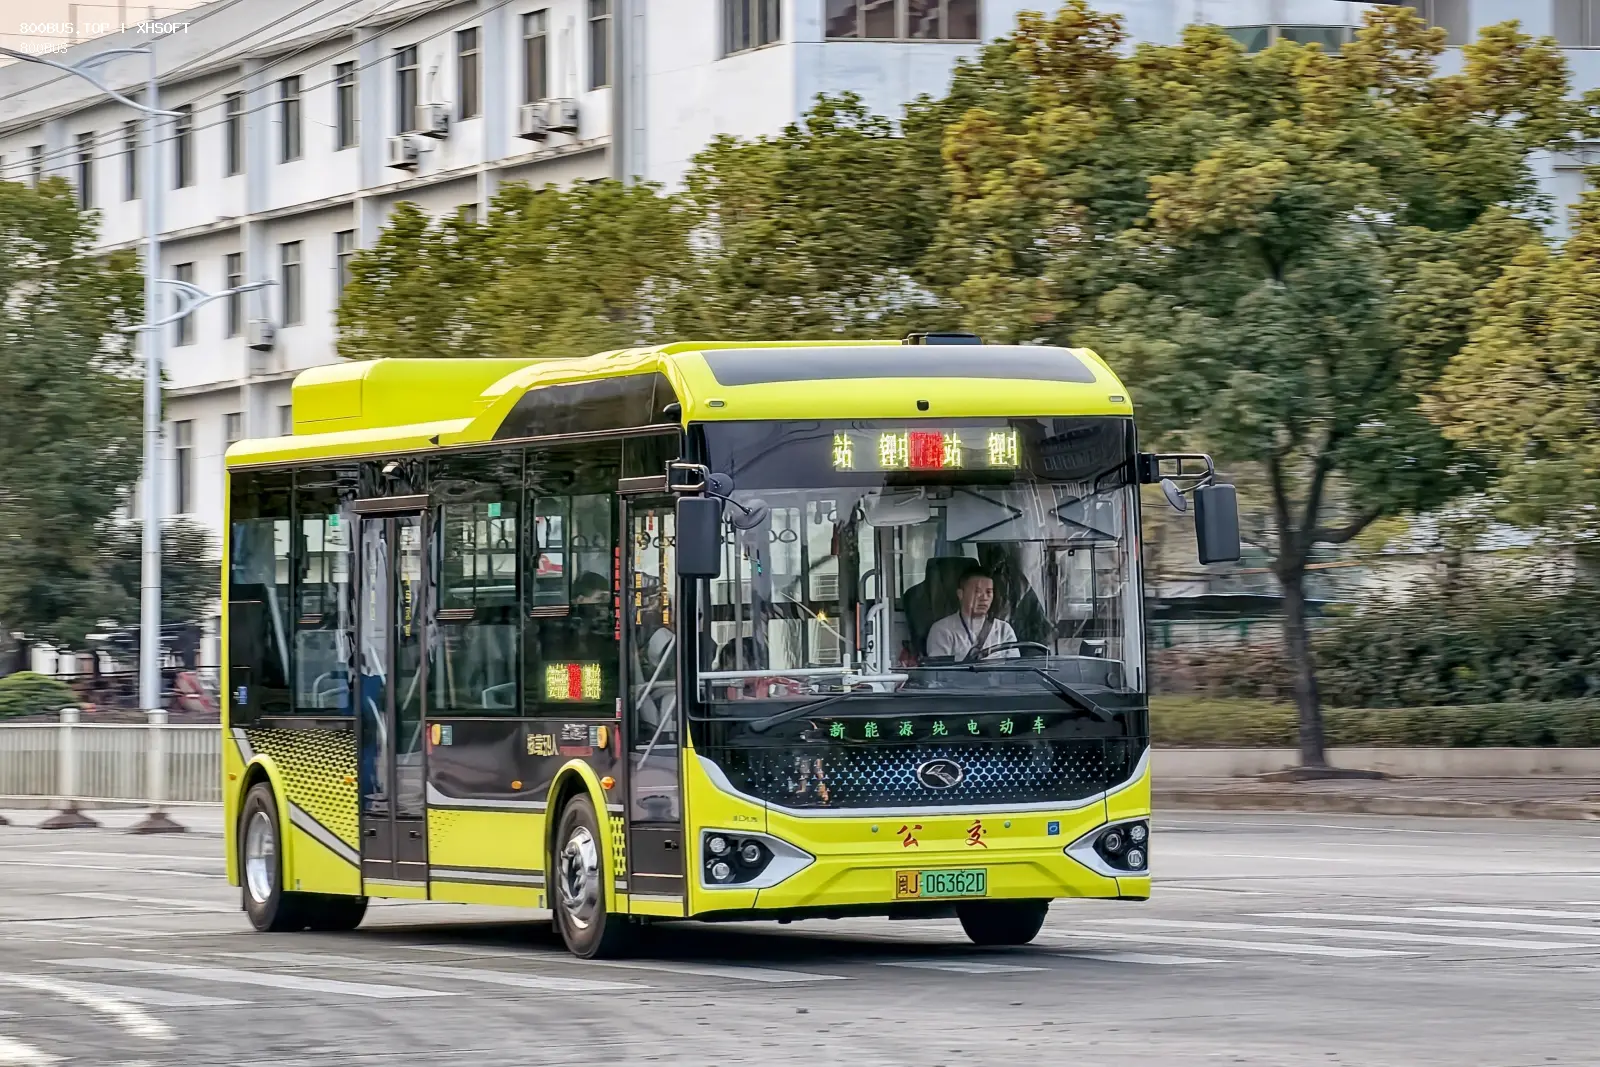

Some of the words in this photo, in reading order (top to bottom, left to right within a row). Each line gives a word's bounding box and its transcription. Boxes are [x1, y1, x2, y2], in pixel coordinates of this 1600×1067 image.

[829, 716, 1046, 740] 新能源纯电动车
[897, 819, 988, 848] 公交
